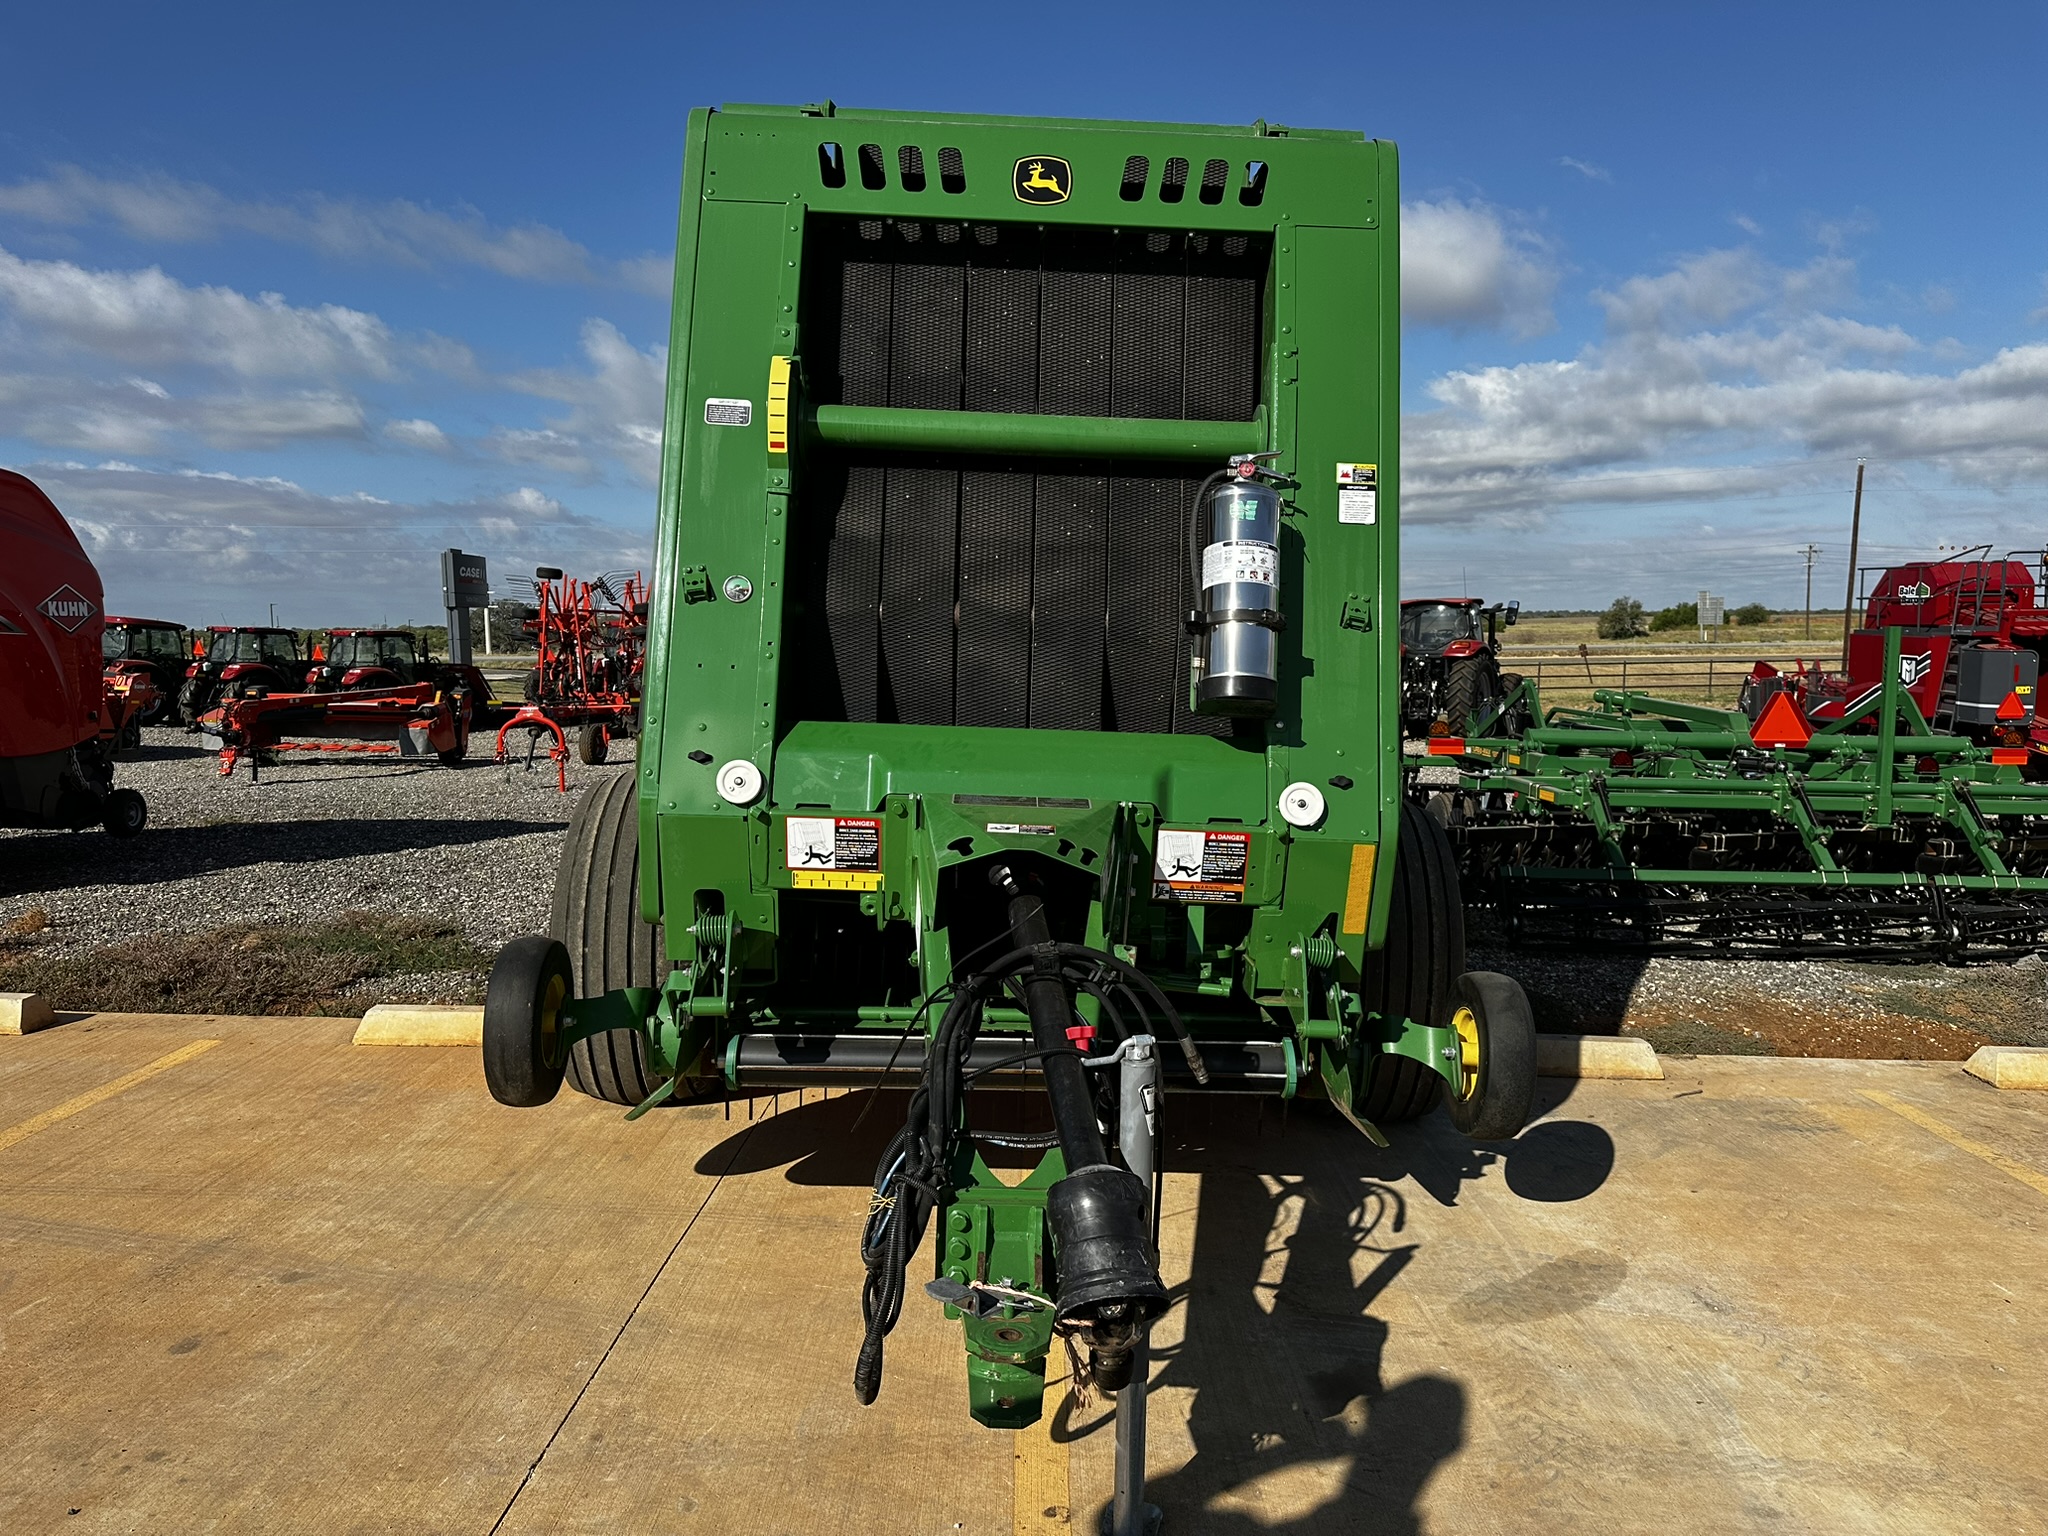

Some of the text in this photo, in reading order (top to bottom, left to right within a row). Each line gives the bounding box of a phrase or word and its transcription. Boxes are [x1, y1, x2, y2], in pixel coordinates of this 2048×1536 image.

[460, 566, 480, 578] CASE
[1899, 586, 1916, 595] Bale
[48, 601, 88, 616] KUHN
